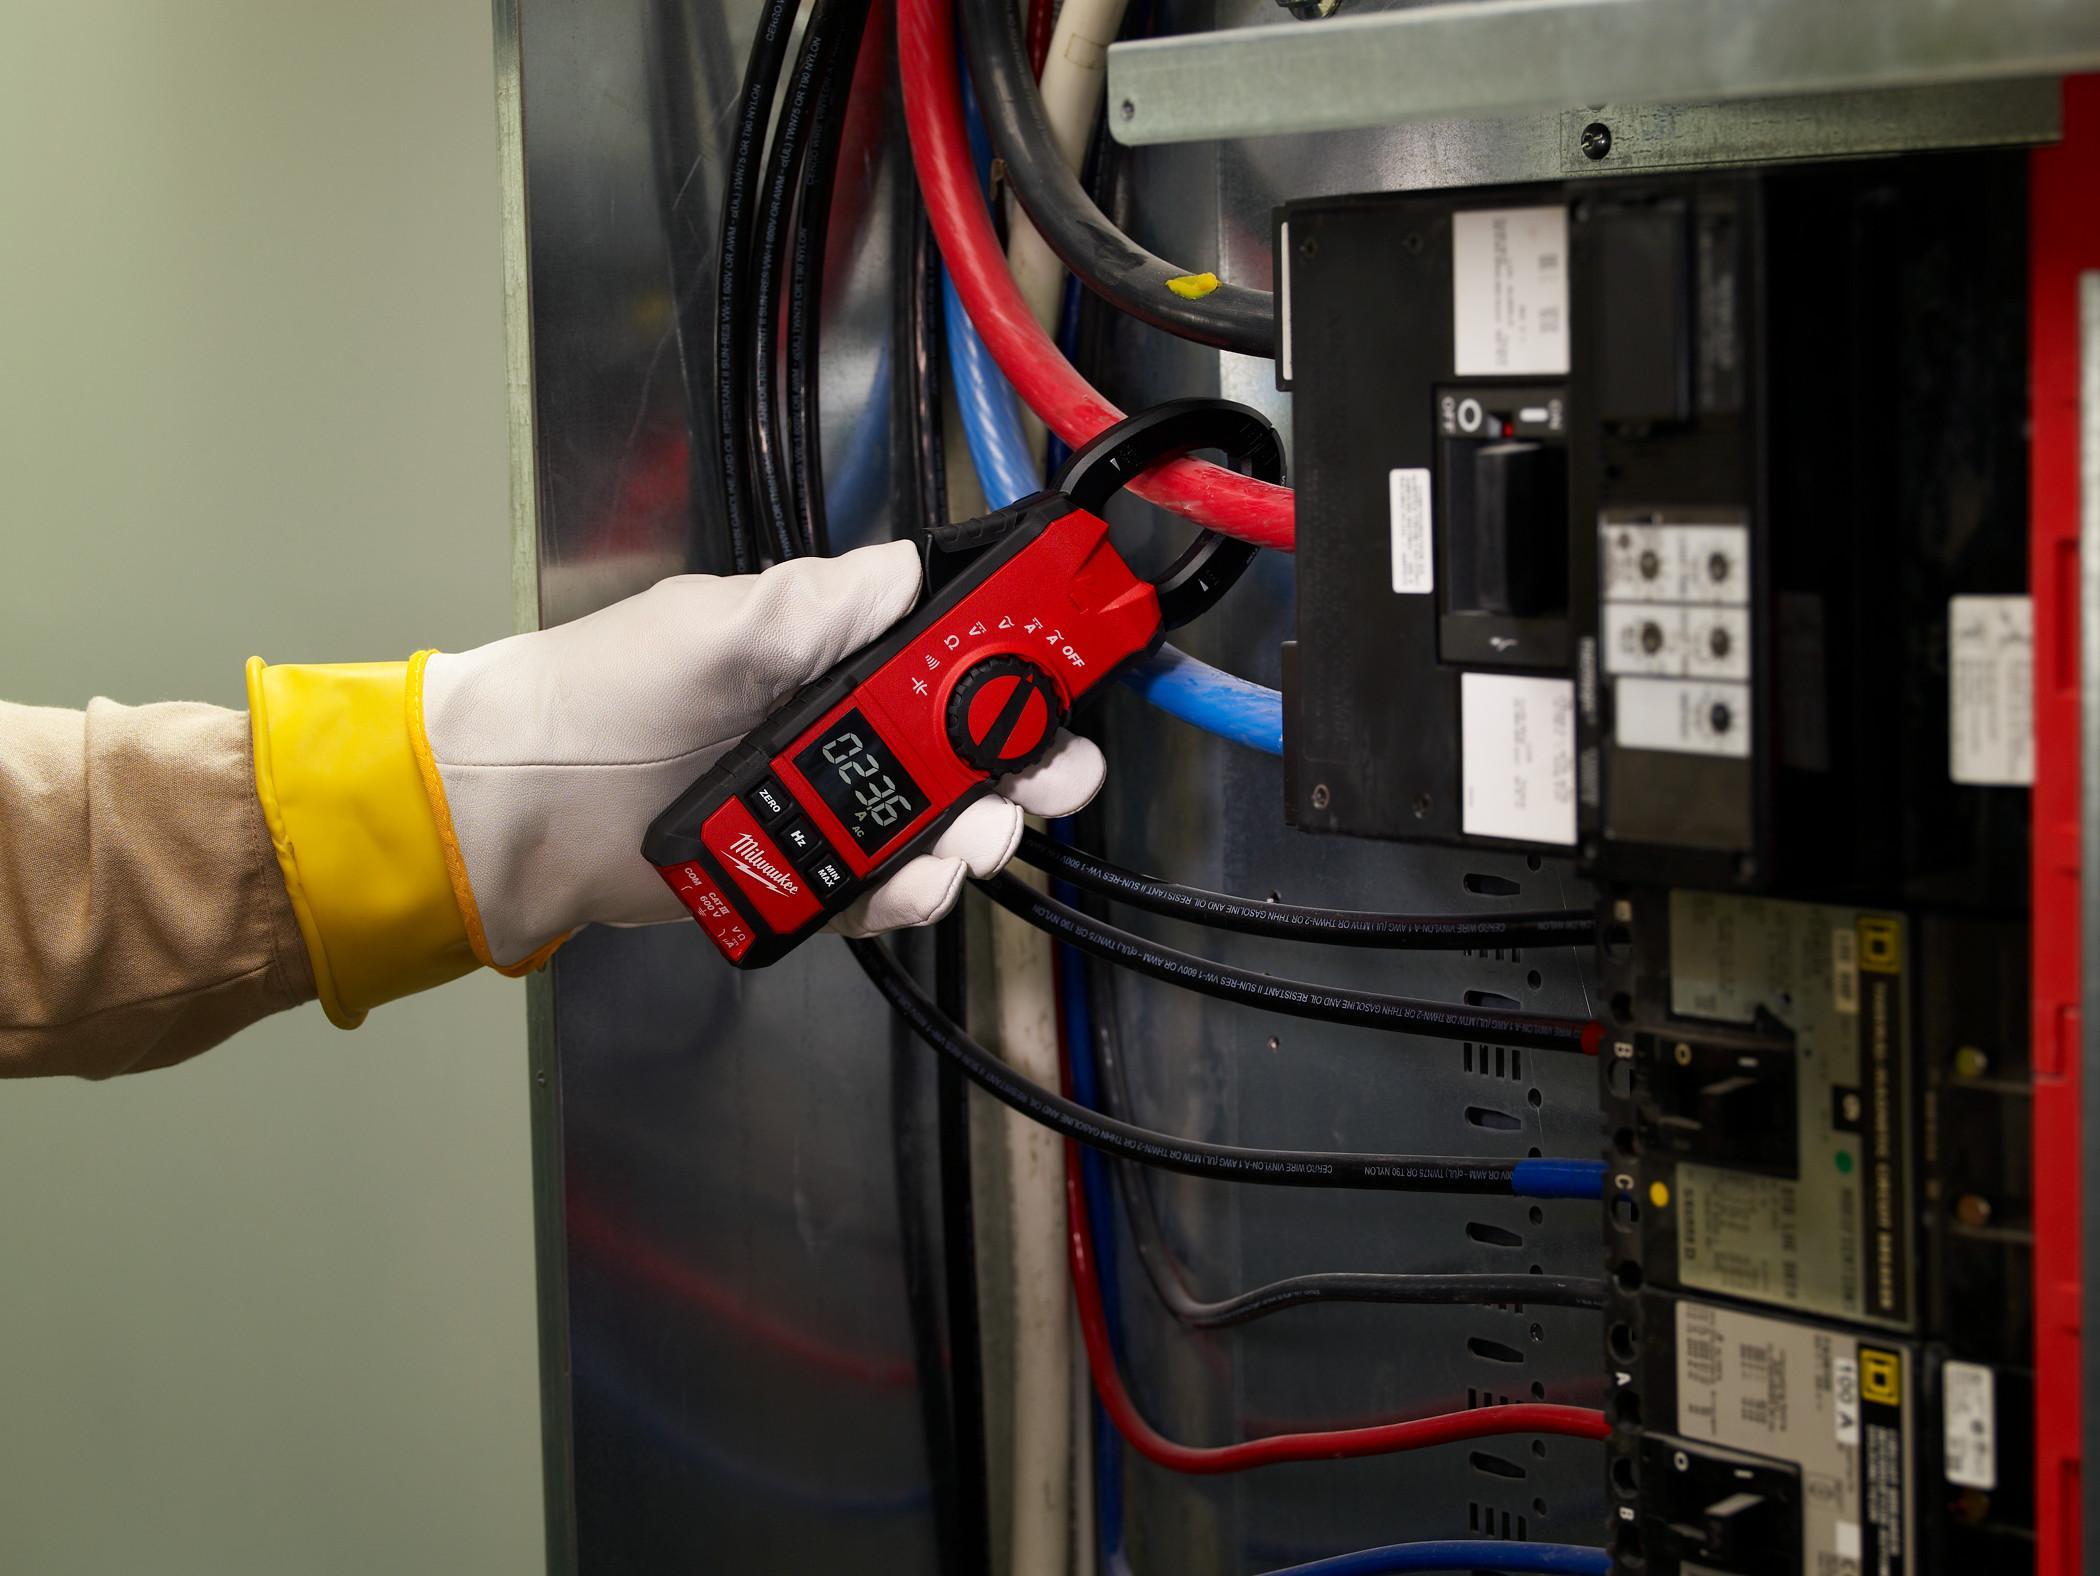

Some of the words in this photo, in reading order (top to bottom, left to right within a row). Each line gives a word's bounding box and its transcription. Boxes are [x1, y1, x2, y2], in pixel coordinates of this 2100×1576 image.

[803, 35, 822, 71] NYLON
[798, 71, 811, 90] T90
[746, 81, 762, 119] NYLON
[793, 90, 805, 106] OR
[784, 106, 801, 140] TWN75
[738, 138, 750, 156] OR
[772, 174, 785, 199] AWM
[769, 200, 780, 217] OR
[725, 225, 737, 251] AWM
[724, 253, 734, 268] OR
[1441, 396, 1456, 433] OFF
[1062, 646, 1086, 668] OFF
[759, 788, 781, 813] ZERO
[854, 812, 868, 822] A
[790, 830, 807, 847] Hz
[852, 825, 864, 838] AC
[730, 832, 798, 895] Milwaukee
[1080, 862, 1102, 878] VW-1
[684, 867, 702, 886] COM
[818, 869, 835, 887] MAX
[825, 864, 840, 880] MIN
[1100, 870, 1140, 891] SUN-RES
[700, 896, 714, 911] 600
[708, 892, 723, 907] CAT
[1192, 897, 1207, 908] OIL
[1206, 900, 1225, 912] AND
[1030, 902, 1061, 924] NYLON
[1225, 904, 1267, 919] GASOLINE
[1266, 911, 1289, 922] THHN
[1290, 914, 1304, 923] OR
[1304, 916, 1336, 927] THWN-2
[1337, 919, 1349, 928] OR
[1349, 920, 1370, 930] MTW
[1387, 922, 1406, 931] AWG
[1073, 924, 1089, 938] OR
[1086, 930, 1117, 950] TWN75
[1141, 952, 1164, 966] AWM
[1162, 959, 1177, 971] OR
[1177, 963, 1197, 977] 600V
[1197, 969, 1219, 983] VW-1
[1219, 975, 1256, 992] SUN-RES
[1262, 985, 1308, 1002] RESISTANT
[1308, 994, 1323, 1005] OIL
[1322, 996, 1341, 1008] AND
[1341, 999, 1380, 1014] GASOLINE
[1380, 1005, 1402, 1017] THHN
[1403, 1008, 1415, 1018] OR
[1415, 1010, 1445, 1022] THWN-2
[1445, 1014, 1457, 1024] OR
[1614, 1042, 1633, 1059] B
[1122, 1137, 1136, 1149] OR
[1136, 1141, 1169, 1157] THWN-2
[1168, 1149, 1182, 1160] OR
[1181, 1151, 1201, 1163] MTW
[1201, 1153, 1218, 1166] (UL)
[1218, 1156, 1237, 1167] AWG
[1243, 1159, 1284, 1172] VINYLON-A
[1285, 1162, 1305, 1172] WIRE
[1306, 1163, 1332, 1174] CERRO
[1363, 1166, 1390, 1176] NYLON
[1391, 1167, 1404, 1176] T90
[1406, 1168, 1418, 1177] OR
[1418, 1168, 1444, 1178] TWN75
[1469, 1169, 1486, 1179] AWM
[1488, 1169, 1498, 1179] OR
[1500, 1170, 1514, 1180] 00V
[1615, 1173, 1634, 1191] C
[1840, 1366, 1852, 1405] 100
[1840, 1411, 1854, 1428] A
